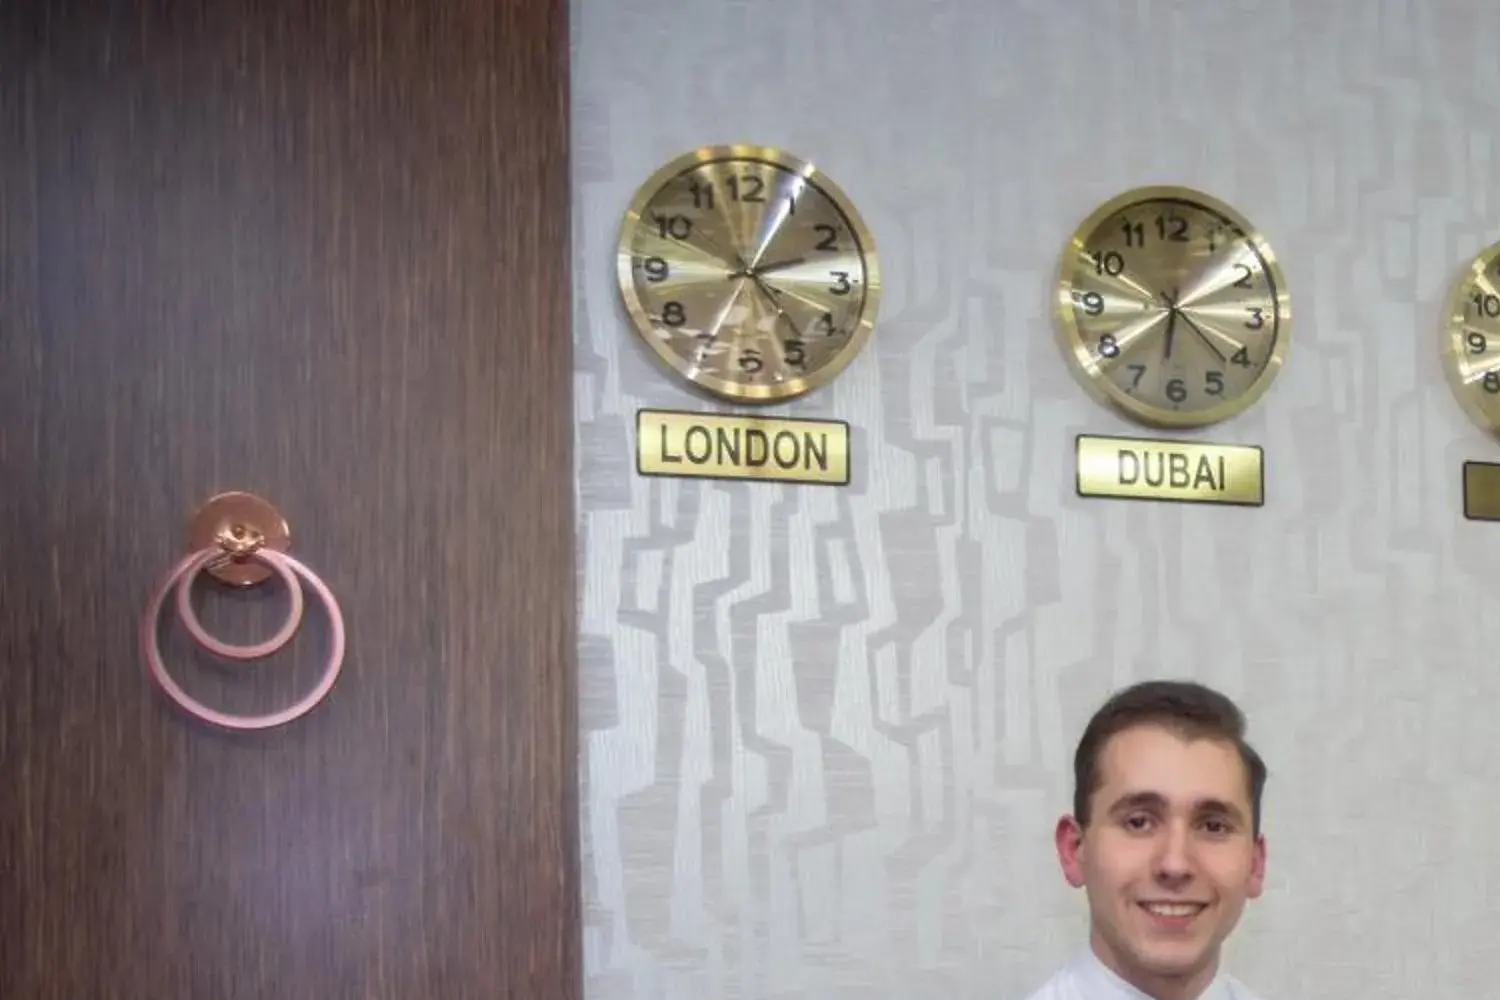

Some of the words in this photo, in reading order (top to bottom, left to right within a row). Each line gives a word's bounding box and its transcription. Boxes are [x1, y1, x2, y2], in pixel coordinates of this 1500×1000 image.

[689, 179, 714, 210] 11
[727, 176, 765, 202] 12
[815, 225, 838, 251] 2
[1123, 223, 1144, 247] 11
[1155, 217, 1188, 242] 12
[645, 257, 668, 282] 9
[1233, 264, 1252, 288] 2
[829, 272, 850, 295] 3
[662, 302, 686, 326] 8
[1083, 292, 1104, 315] 9
[1472, 295, 1500, 318] 10
[1246, 309, 1262, 330] 3
[1098, 334, 1119, 359] 8
[1468, 332, 1486, 354] 9
[1231, 346, 1250, 367] 4
[1128, 366, 1146, 387] 7
[1204, 372, 1224, 395] 5
[1483, 372, 1500, 393] 8
[1166, 379, 1187, 402] 6
[661, 424, 827, 471] LONDON
[1118, 449, 1225, 490] DUBAI
